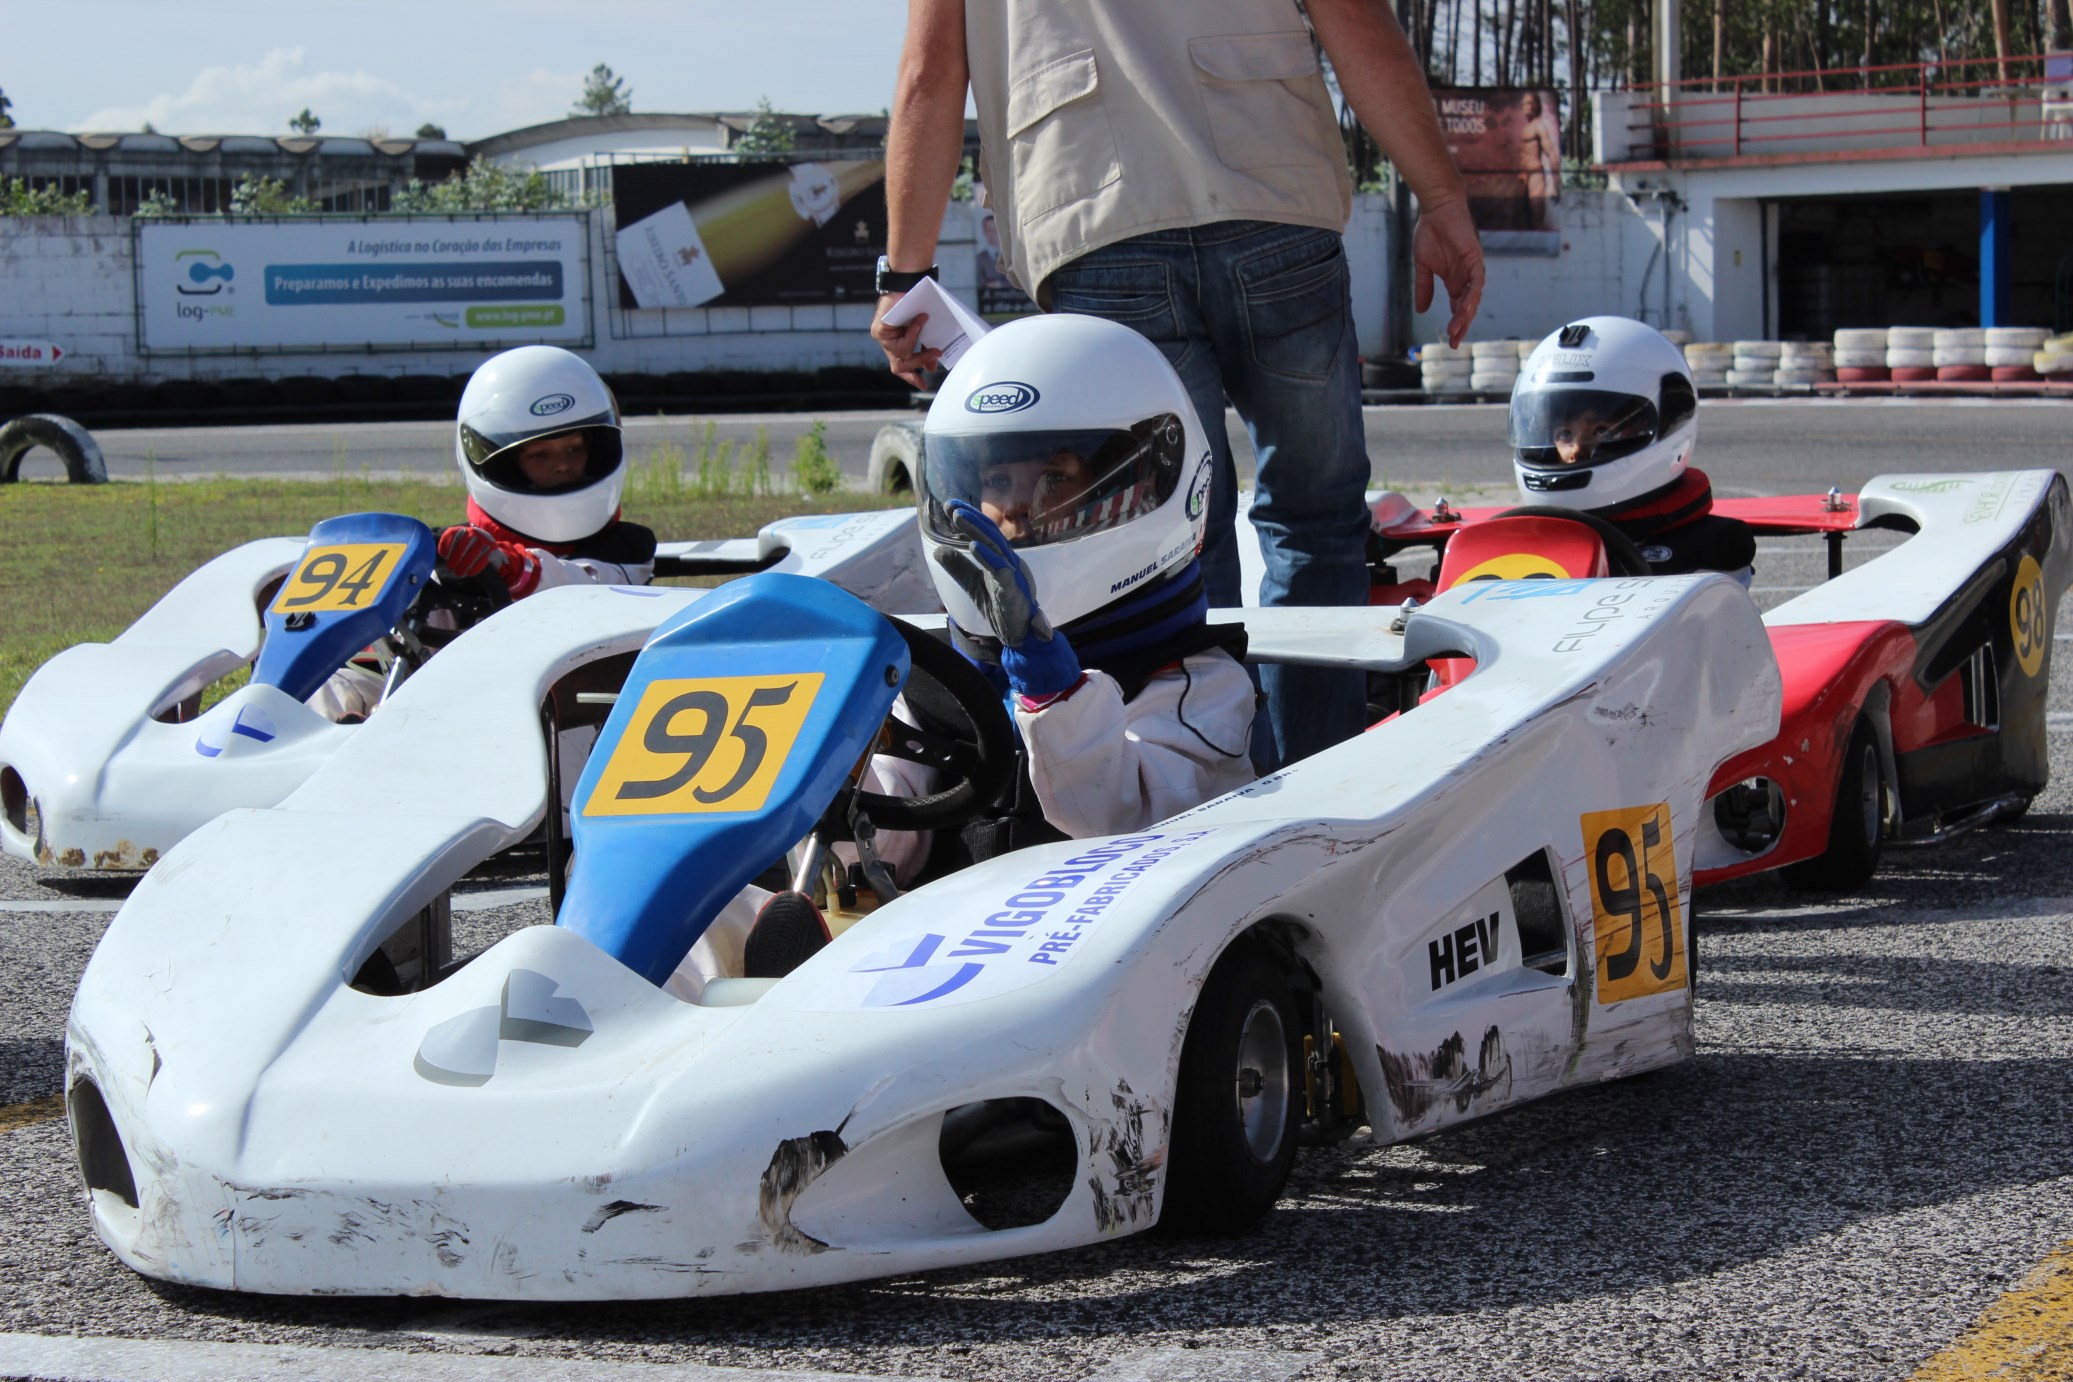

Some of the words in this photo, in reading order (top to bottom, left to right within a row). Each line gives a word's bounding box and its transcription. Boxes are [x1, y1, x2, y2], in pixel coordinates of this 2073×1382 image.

[1441, 99, 1485, 115] MUSEU
[1446, 117, 1486, 134] TODOS
[347, 240, 356, 254] A
[414, 242, 430, 253] no
[432, 239, 480, 256] Coração
[482, 238, 503, 251] das
[505, 238, 561, 253] Empresas
[274, 276, 350, 293] Preparamos
[352, 279, 360, 289] e
[363, 274, 429, 292] Expedimos
[431, 277, 445, 288] as
[447, 275, 474, 287] suas
[477, 272, 553, 287] encomendas
[284, 549, 389, 607] 94
[1110, 561, 1158, 594] MANUEL
[1160, 532, 1197, 566] SARAIVA
[2015, 577, 2045, 659] 98
[615, 681, 798, 804] 95
[1197, 788, 1255, 812] SARAIVA
[947, 834, 1166, 957] VIGOBLOCO
[1595, 810, 1674, 982] 95
[1428, 911, 1500, 992] HEV
